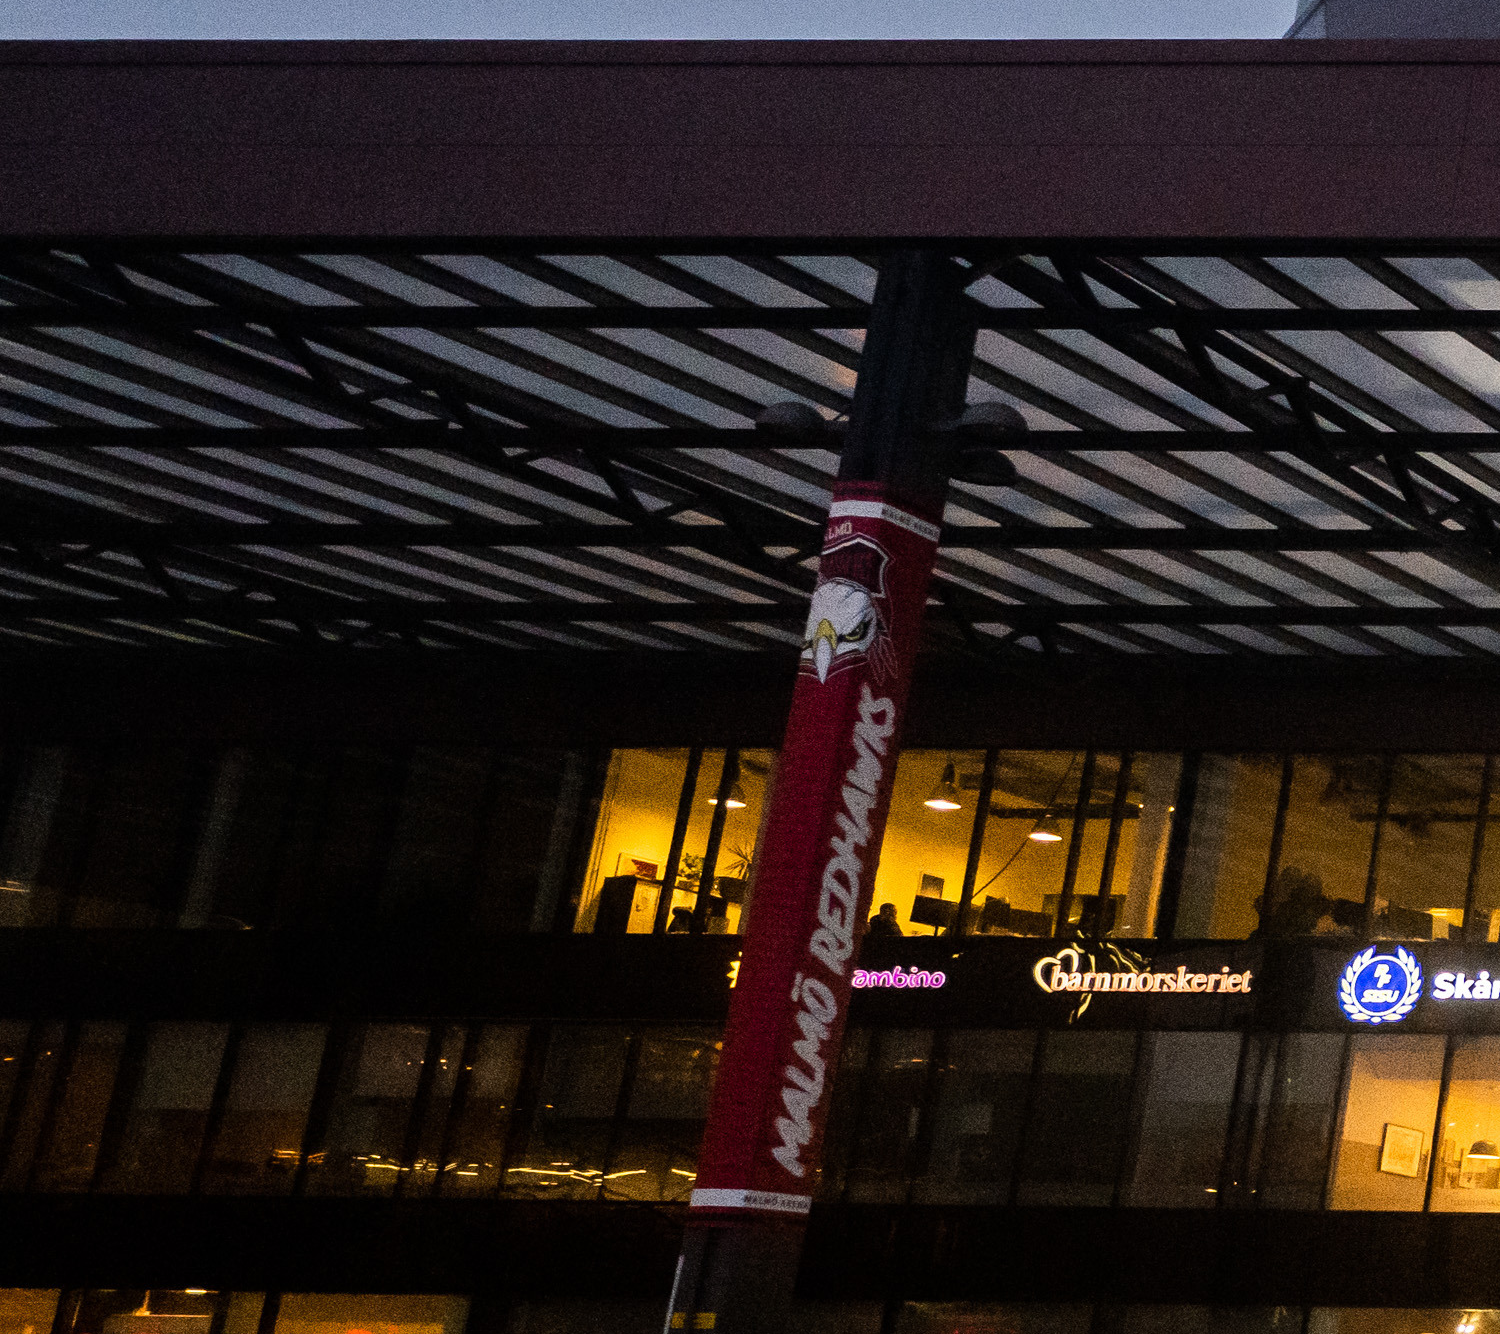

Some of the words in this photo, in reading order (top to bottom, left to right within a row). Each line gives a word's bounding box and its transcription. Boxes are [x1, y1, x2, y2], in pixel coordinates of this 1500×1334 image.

[772, 973, 838, 1179] MALMÖ
[809, 681, 896, 976] REDHAWKS
[850, 964, 946, 989] ambino
[1050, 964, 1253, 994] barnmorskeriet
